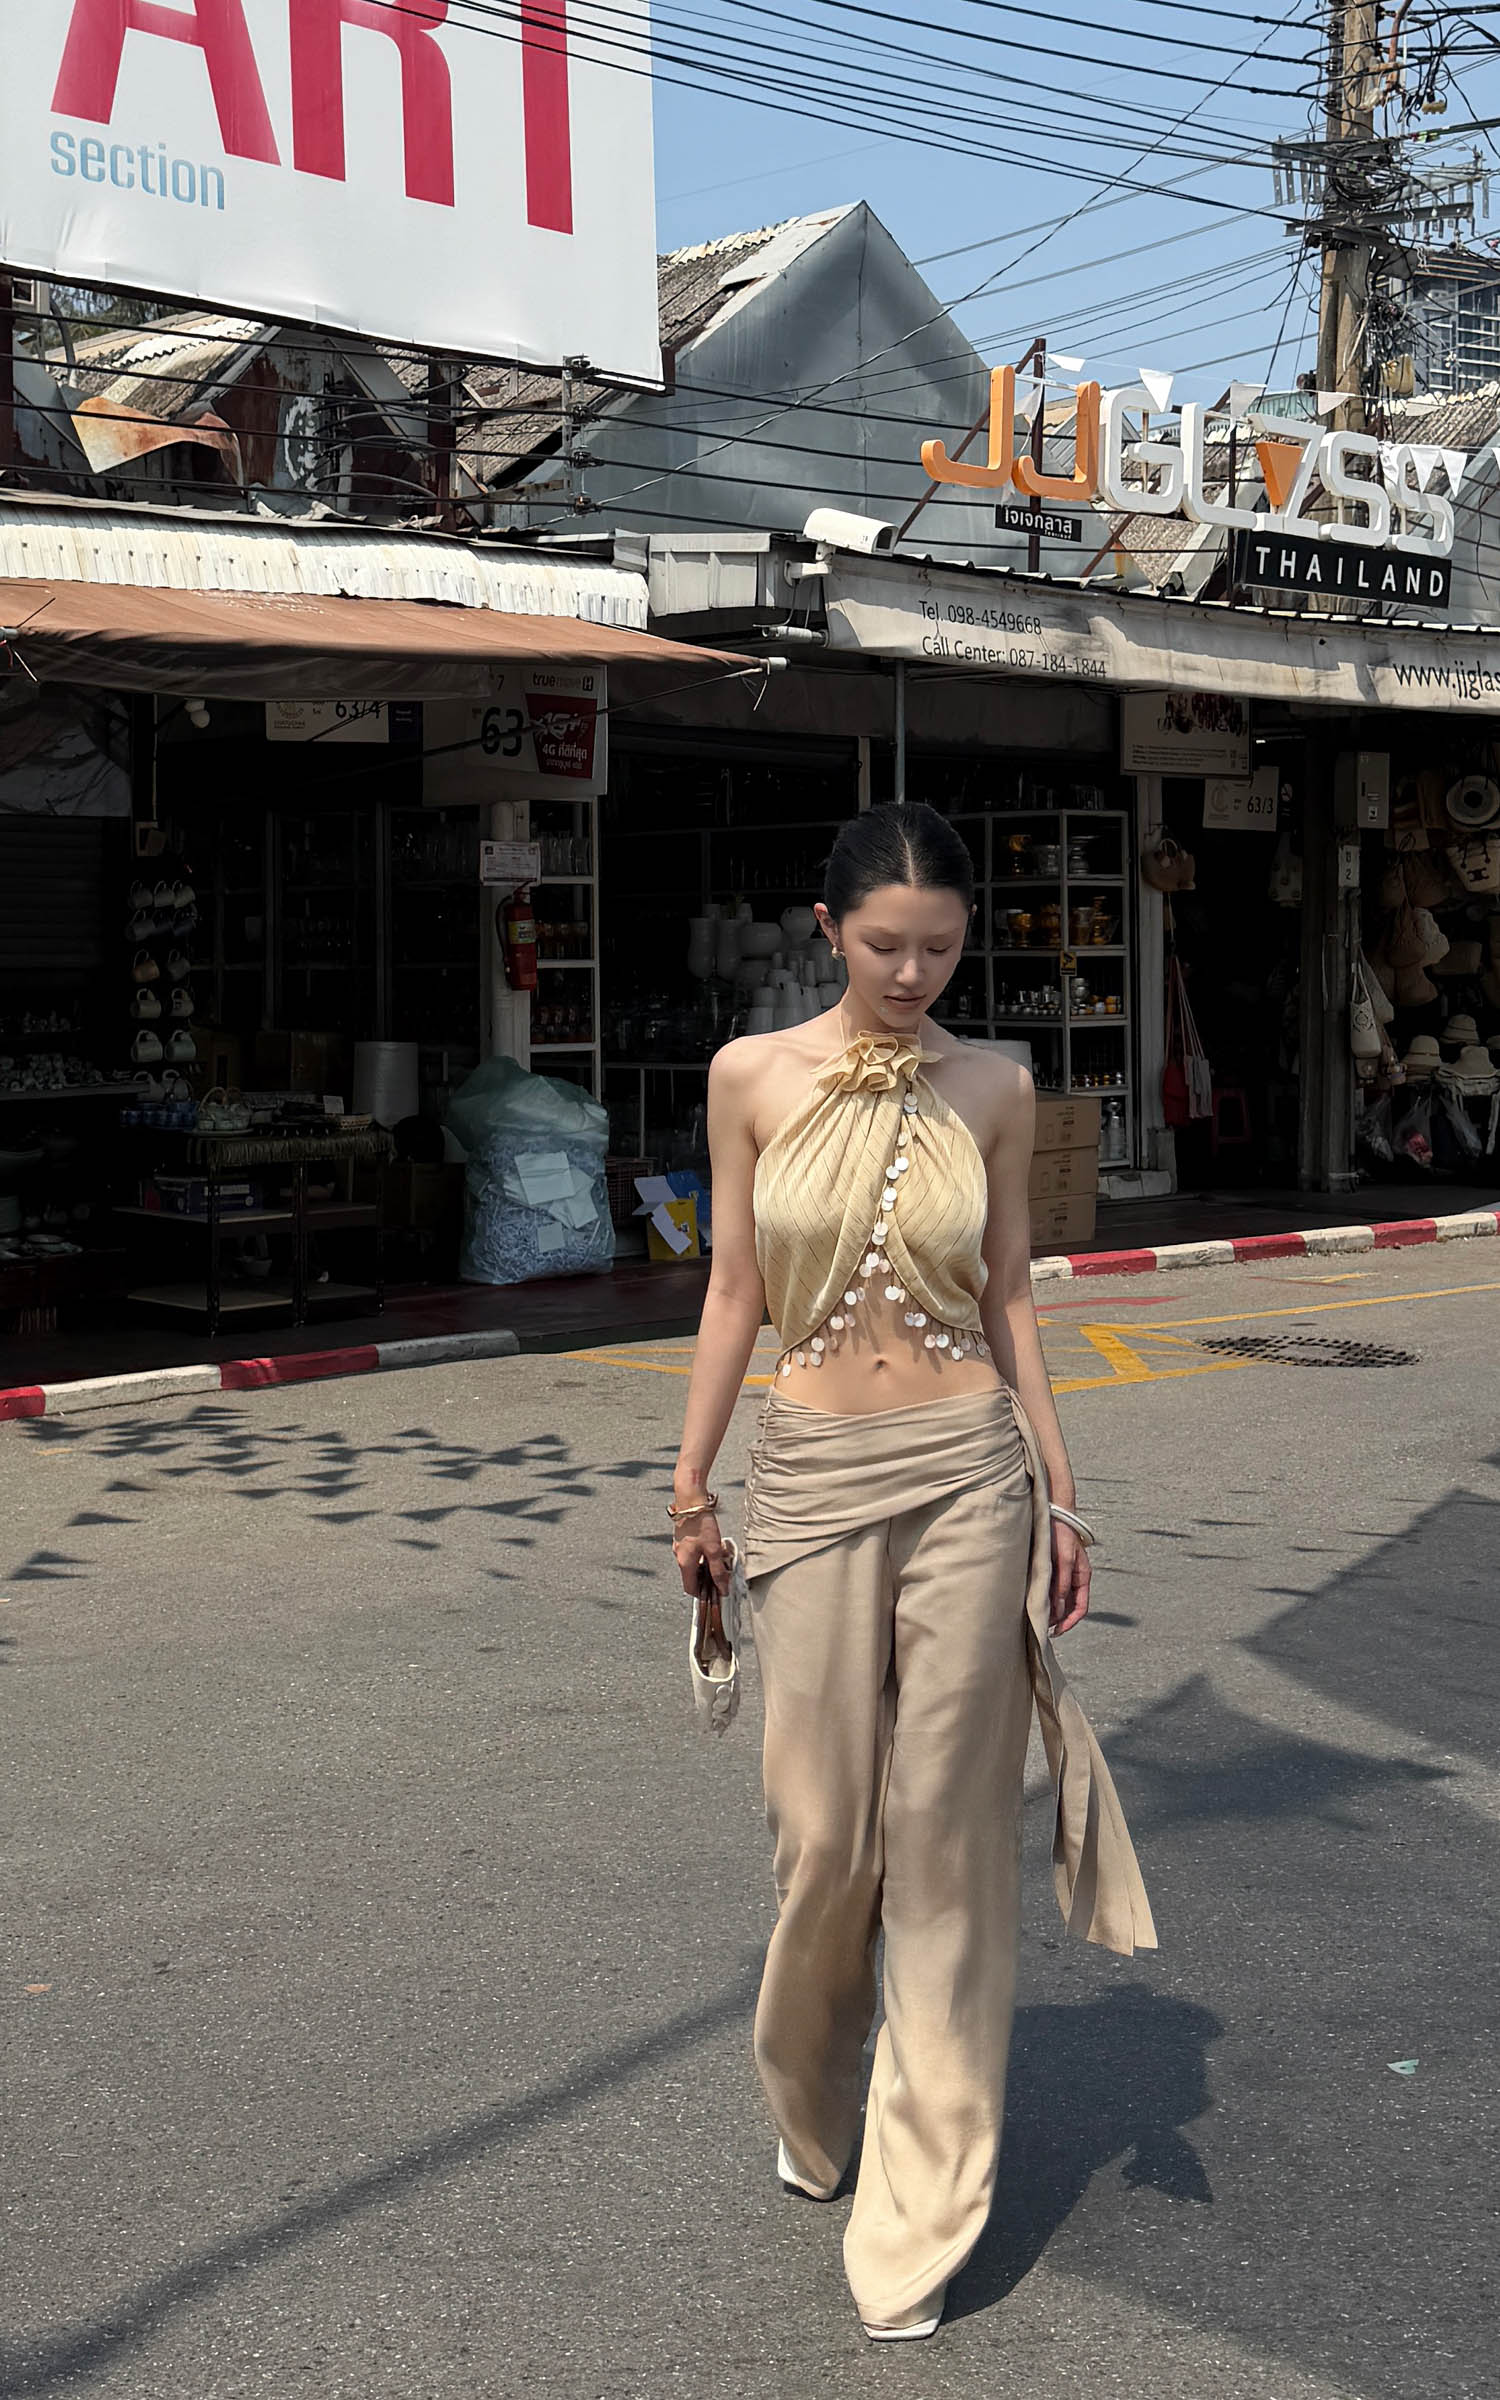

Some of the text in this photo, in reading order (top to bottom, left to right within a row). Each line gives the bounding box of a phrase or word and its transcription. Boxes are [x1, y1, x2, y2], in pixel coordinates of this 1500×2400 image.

[49, 129, 226, 211] section
[1255, 545, 1445, 598] THAILAND
[919, 599, 1042, 635] Tel. 098-4549668
[922, 636, 1107, 679] Call Center: 087-184-1844
[481, 706, 524, 757] 63
